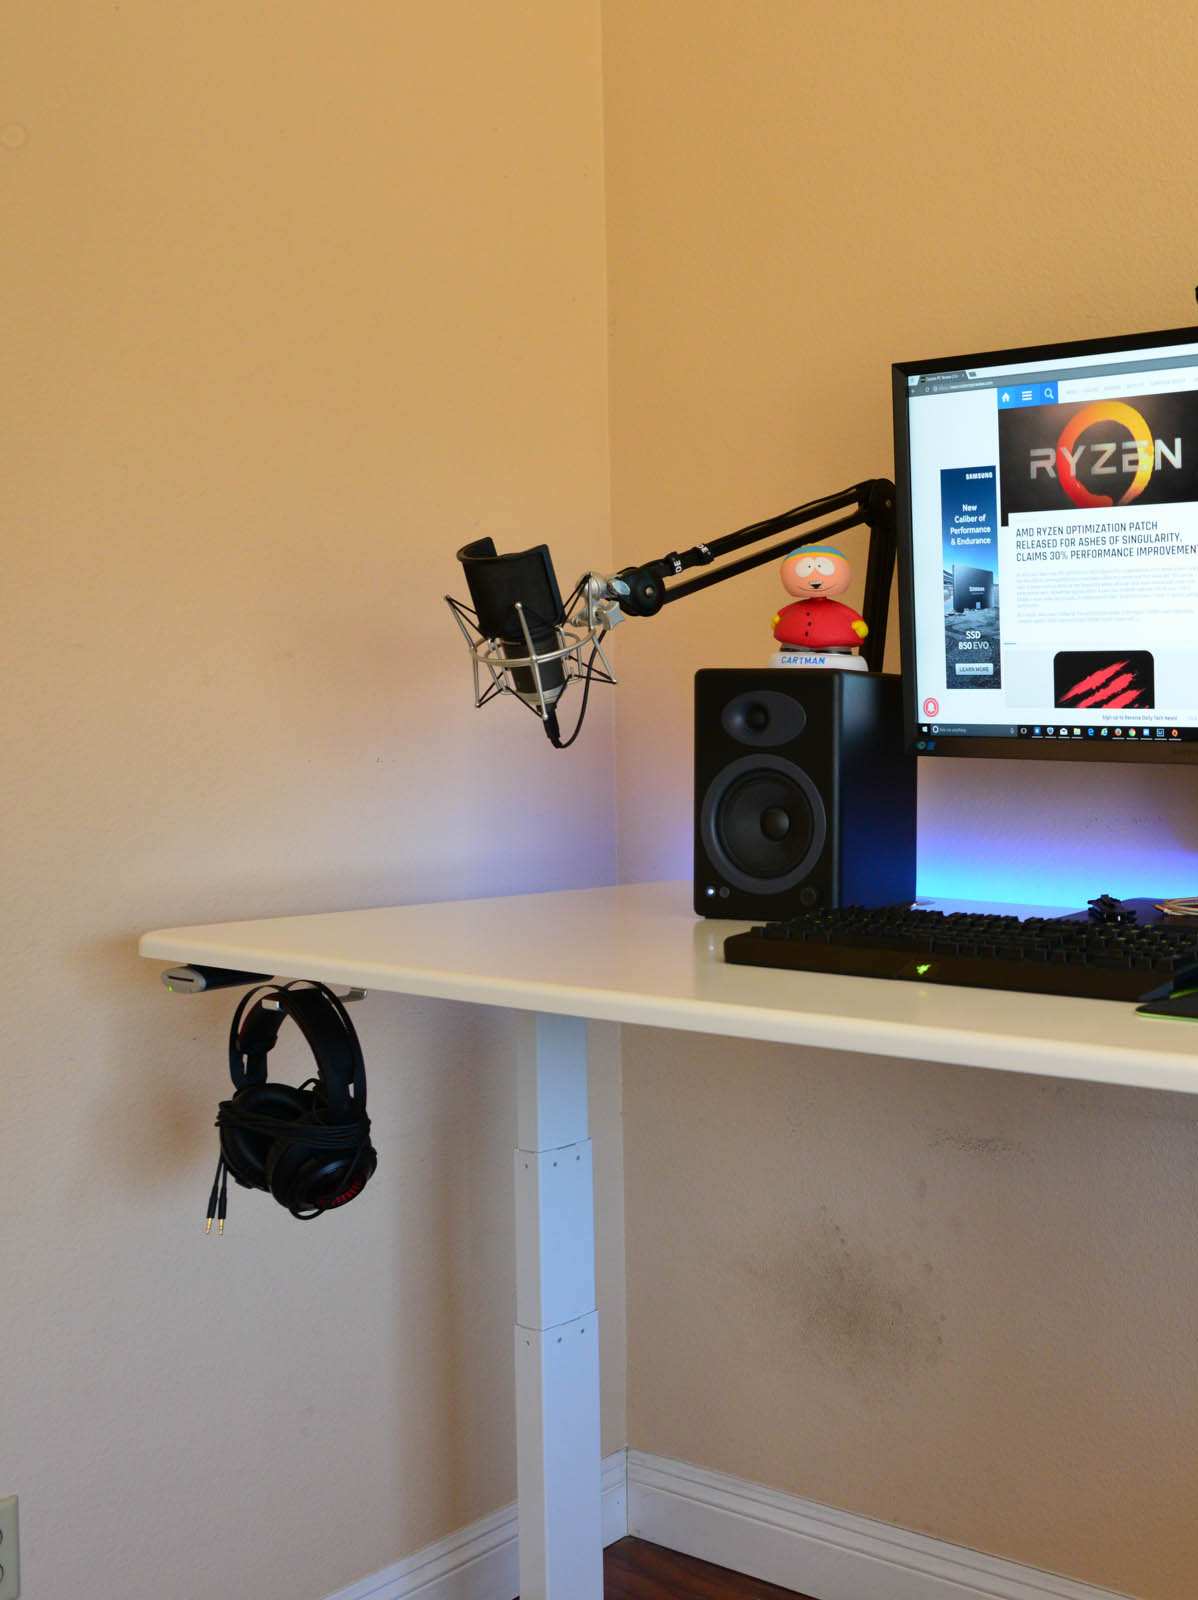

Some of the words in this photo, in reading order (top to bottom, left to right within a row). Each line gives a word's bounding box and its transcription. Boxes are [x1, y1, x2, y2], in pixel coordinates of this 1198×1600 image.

[1030, 437, 1182, 479] RYZEN
[966, 472, 993, 480] SAMSUNG
[962, 504, 977, 512] New
[955, 515, 978, 523] Caliber
[979, 514, 987, 522] of
[950, 526, 991, 535] Performance
[1016, 528, 1034, 537] AMD
[1037, 526, 1064, 536] RYZEN
[1066, 523, 1126, 535] OPTIMIZATION
[1129, 521, 1158, 531] PATCH
[951, 538, 956, 546] &
[957, 537, 991, 546] Endurance
[1016, 539, 1057, 550] RELEASED
[1060, 538, 1076, 547] FOR
[1078, 536, 1107, 547] ASHES
[1109, 535, 1120, 545] OF
[1122, 532, 1183, 545] SINGULARITY,
[1016, 551, 1047, 562] CLAIMS
[1050, 551, 1069, 560] 30%
[1070, 547, 1134, 560] PERFORMANCE
[966, 631, 981, 639] SSD
[958, 641, 972, 650] 850
[973, 641, 989, 650] EVO
[781, 656, 825, 665] CARTMAN
